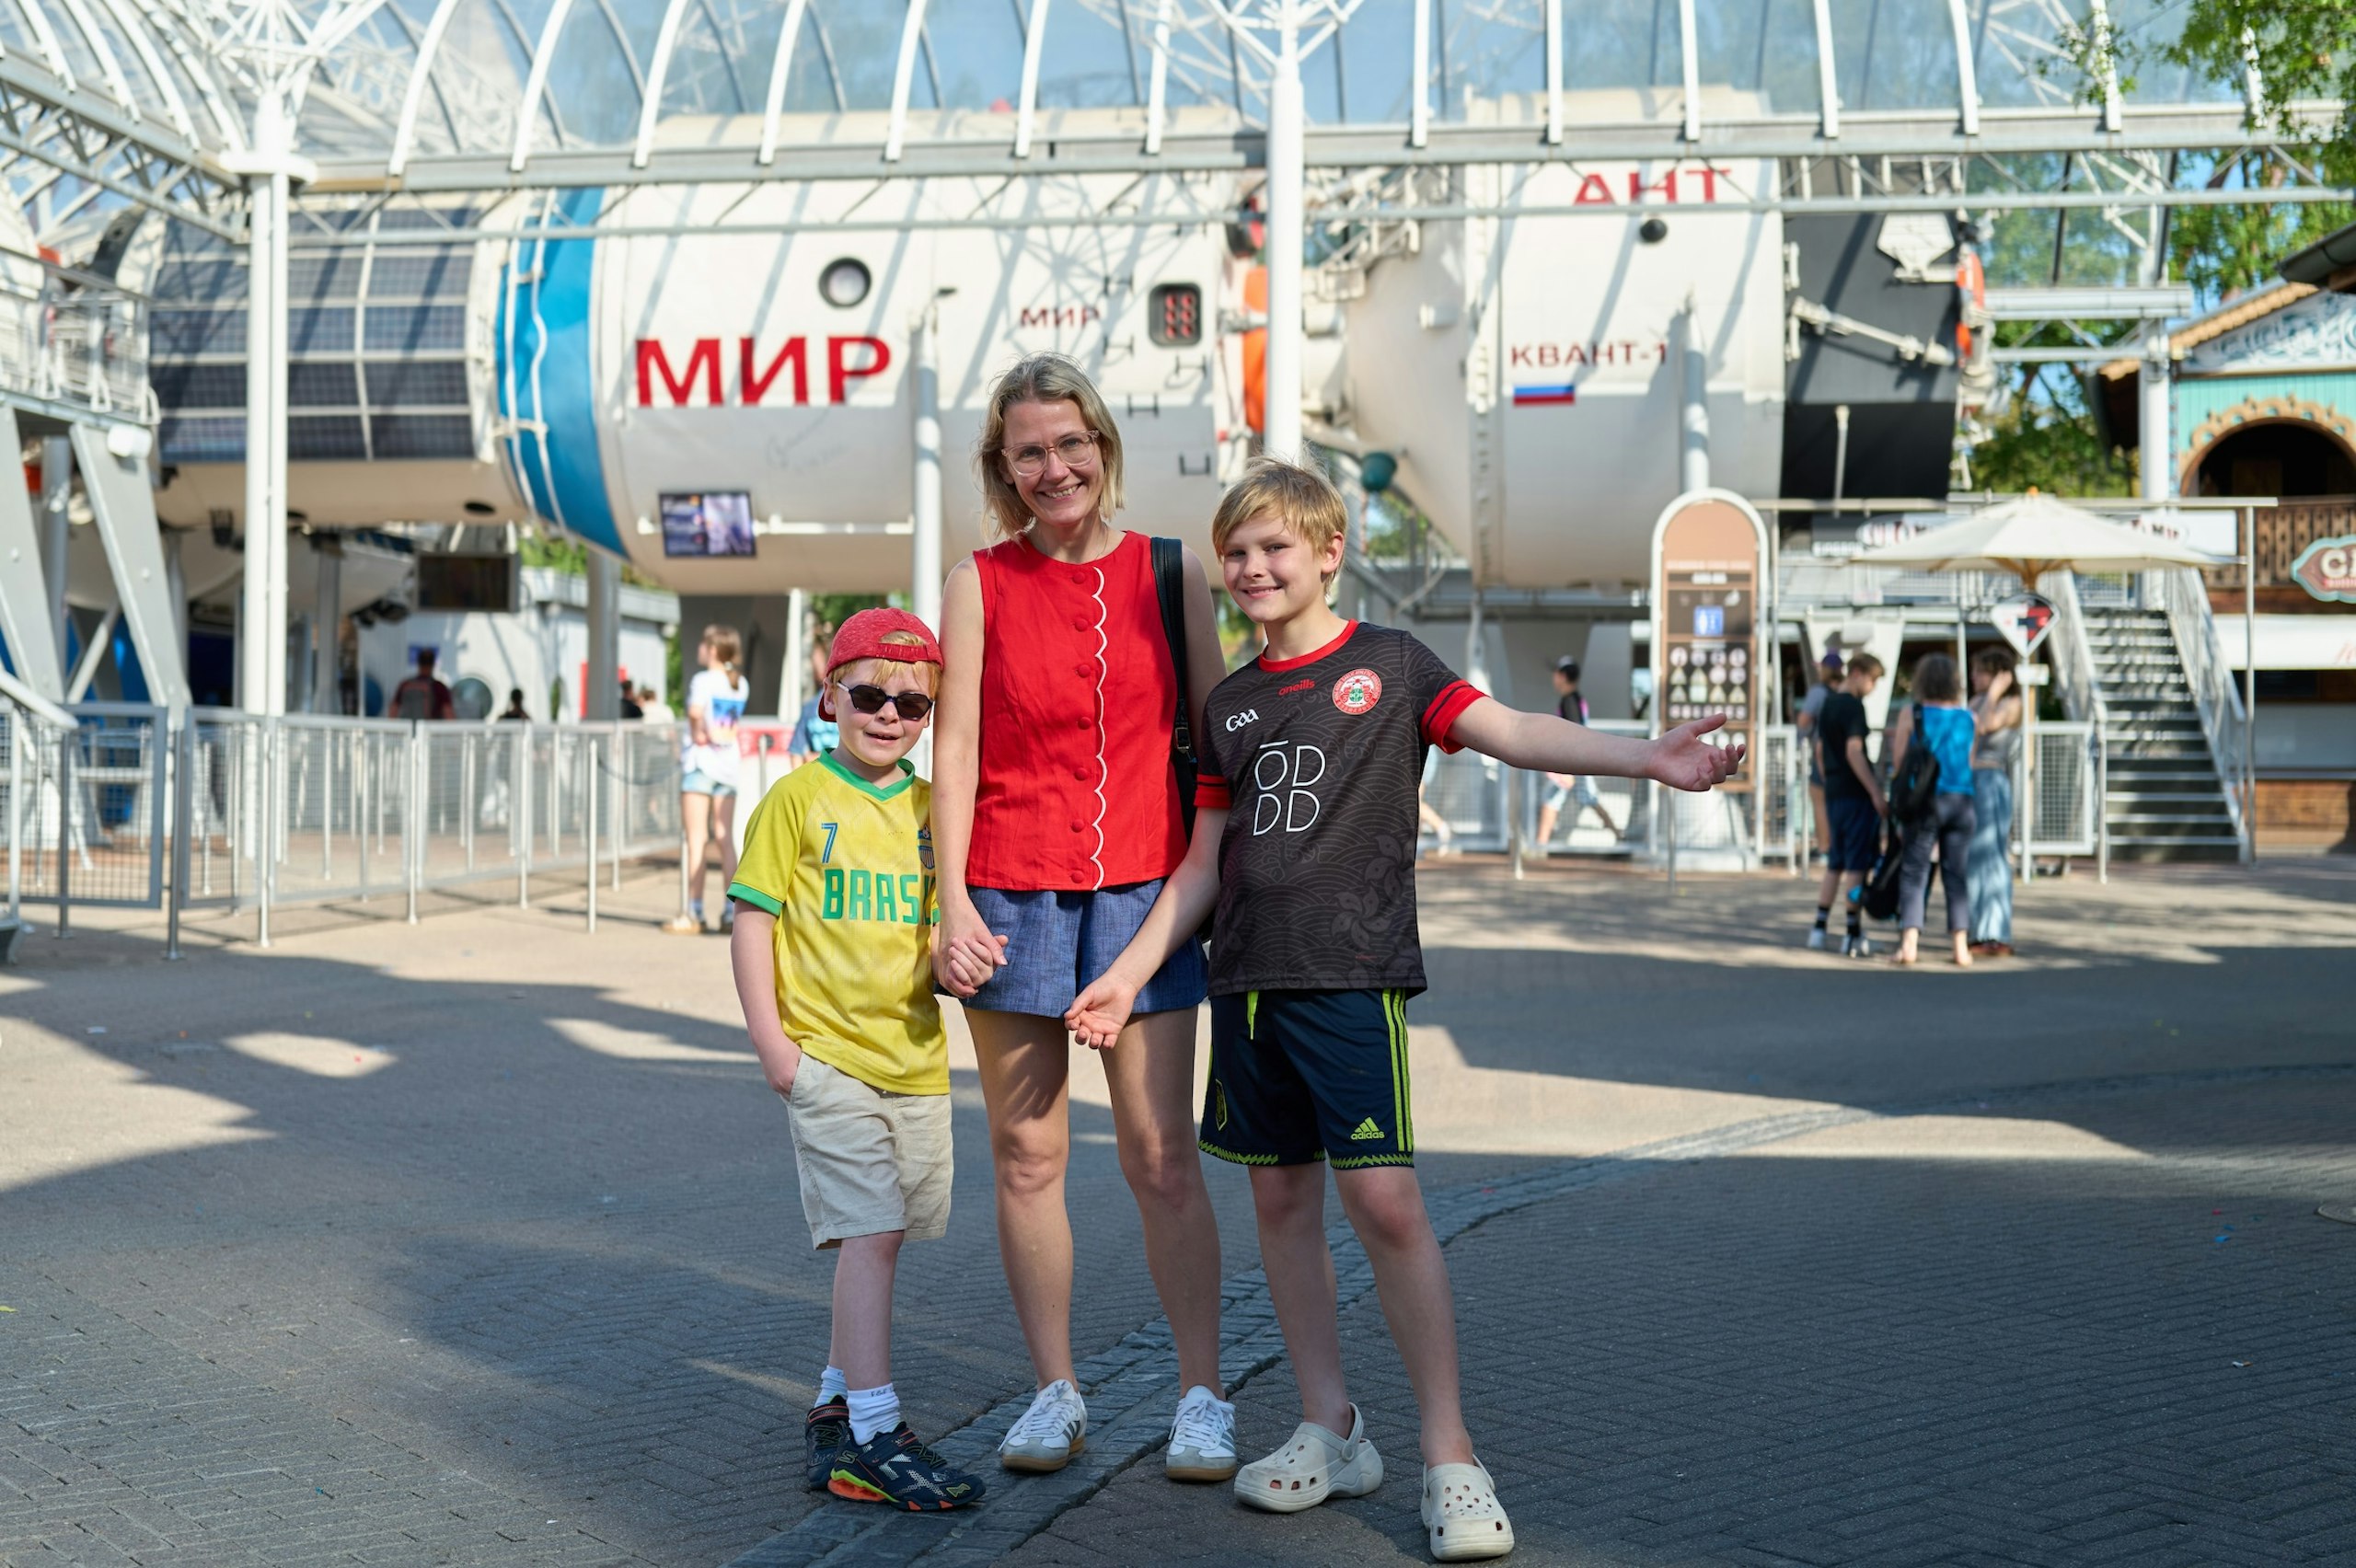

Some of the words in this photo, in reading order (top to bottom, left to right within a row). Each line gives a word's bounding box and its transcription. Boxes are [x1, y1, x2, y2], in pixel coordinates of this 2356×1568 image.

[1021, 306, 1100, 329] МИР
[1511, 341, 1667, 367] КВАНТ-1
[636, 336, 891, 407] МИР
[821, 822, 838, 864] 7
[1350, 1131, 1385, 1140] adidas
